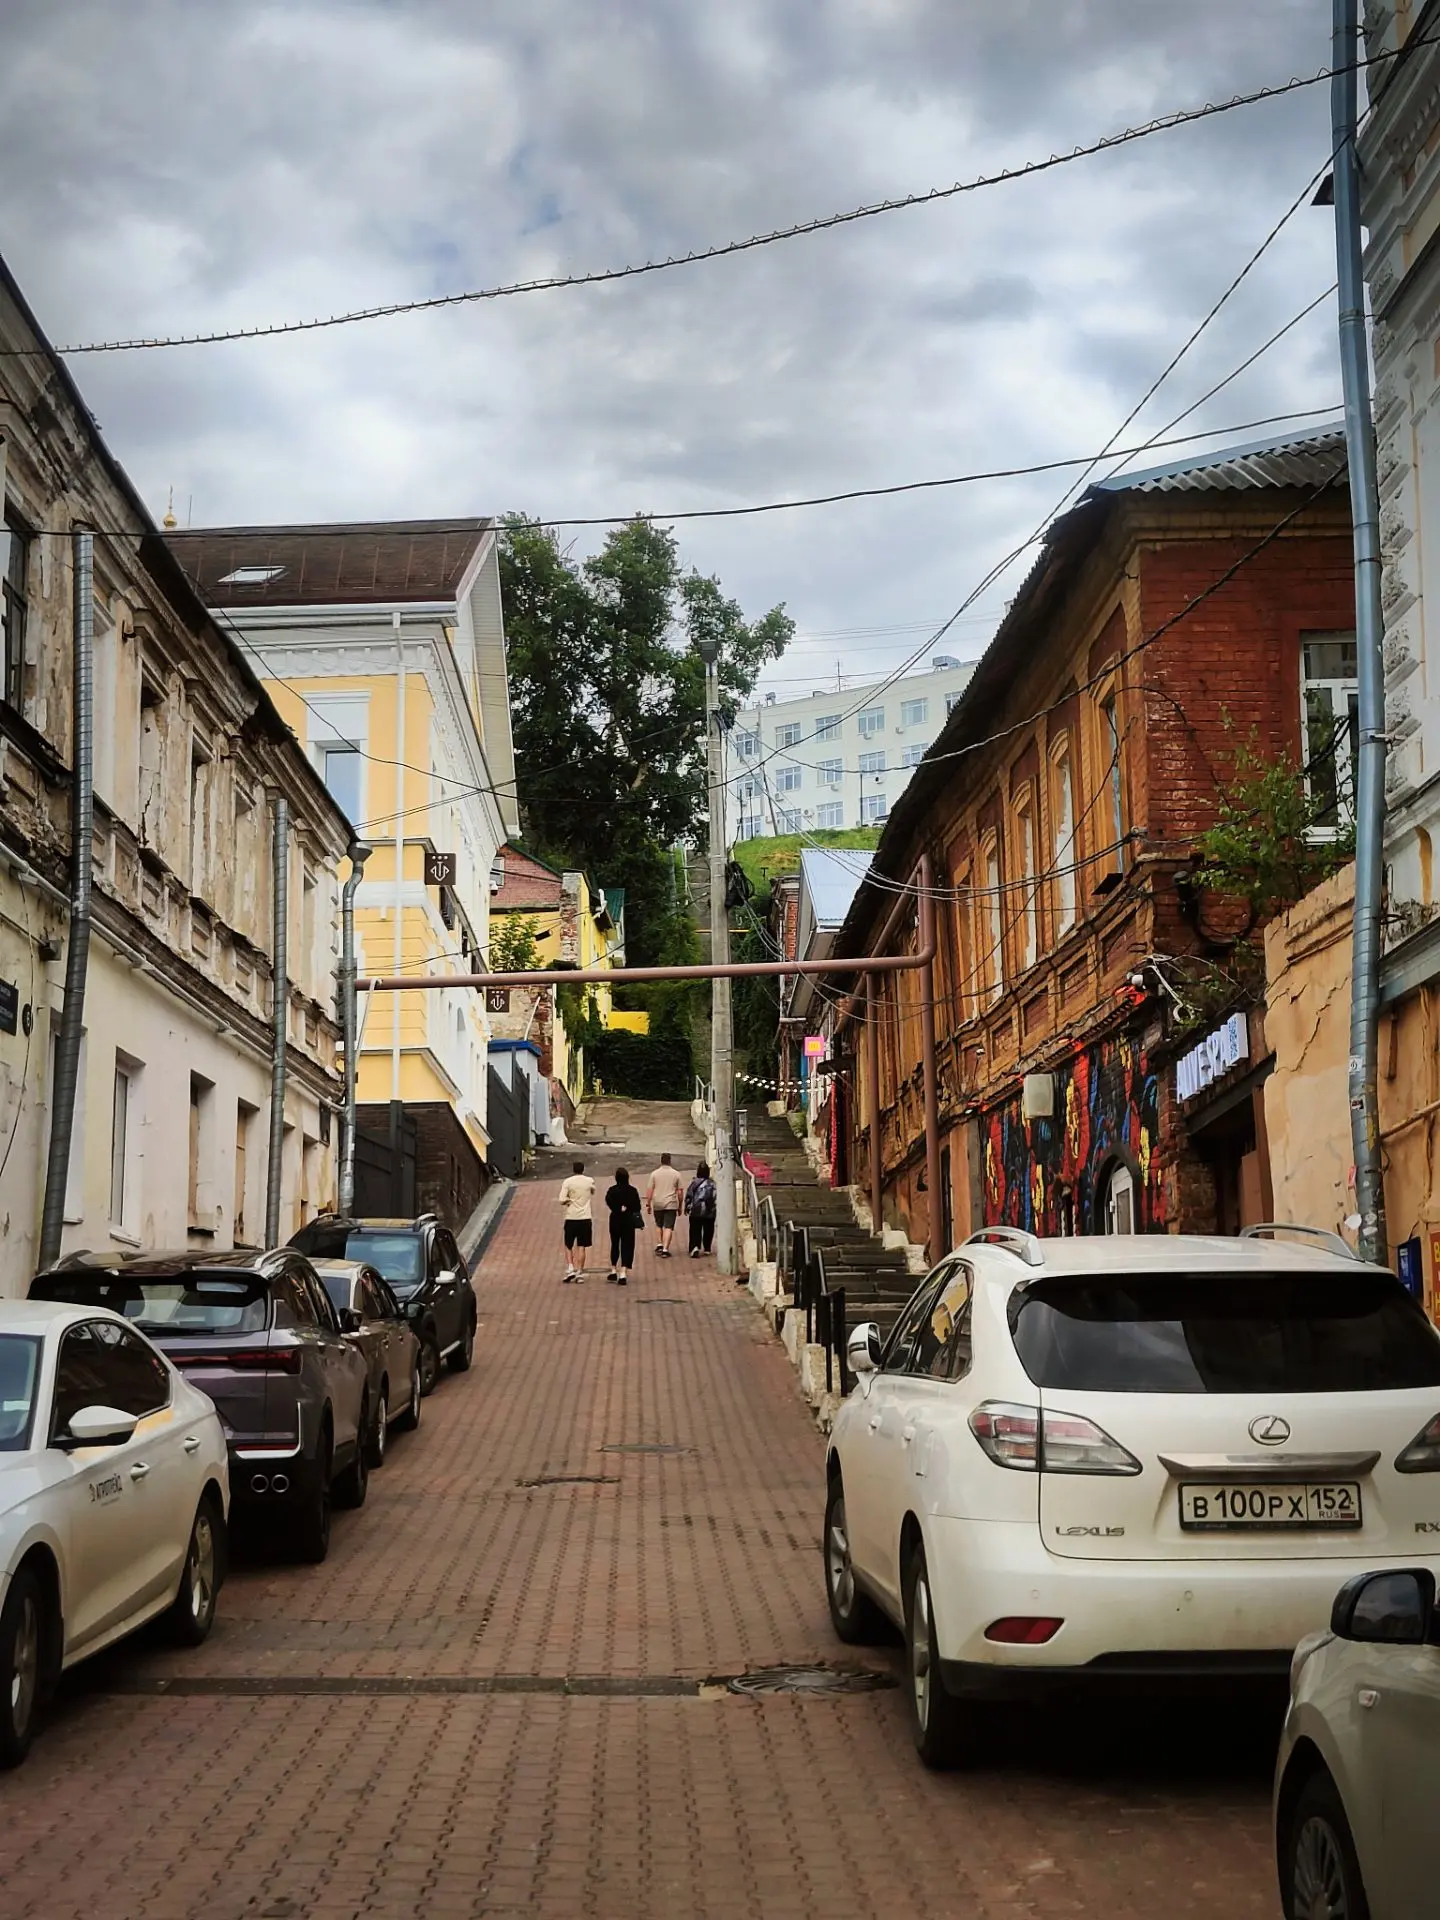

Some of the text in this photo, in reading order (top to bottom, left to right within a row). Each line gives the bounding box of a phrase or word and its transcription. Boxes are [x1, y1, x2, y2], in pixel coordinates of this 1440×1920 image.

[1310, 1488, 1351, 1510] 152
[1318, 1511, 1340, 1519] RUS
[1055, 1526, 1125, 1537] LEXUS
